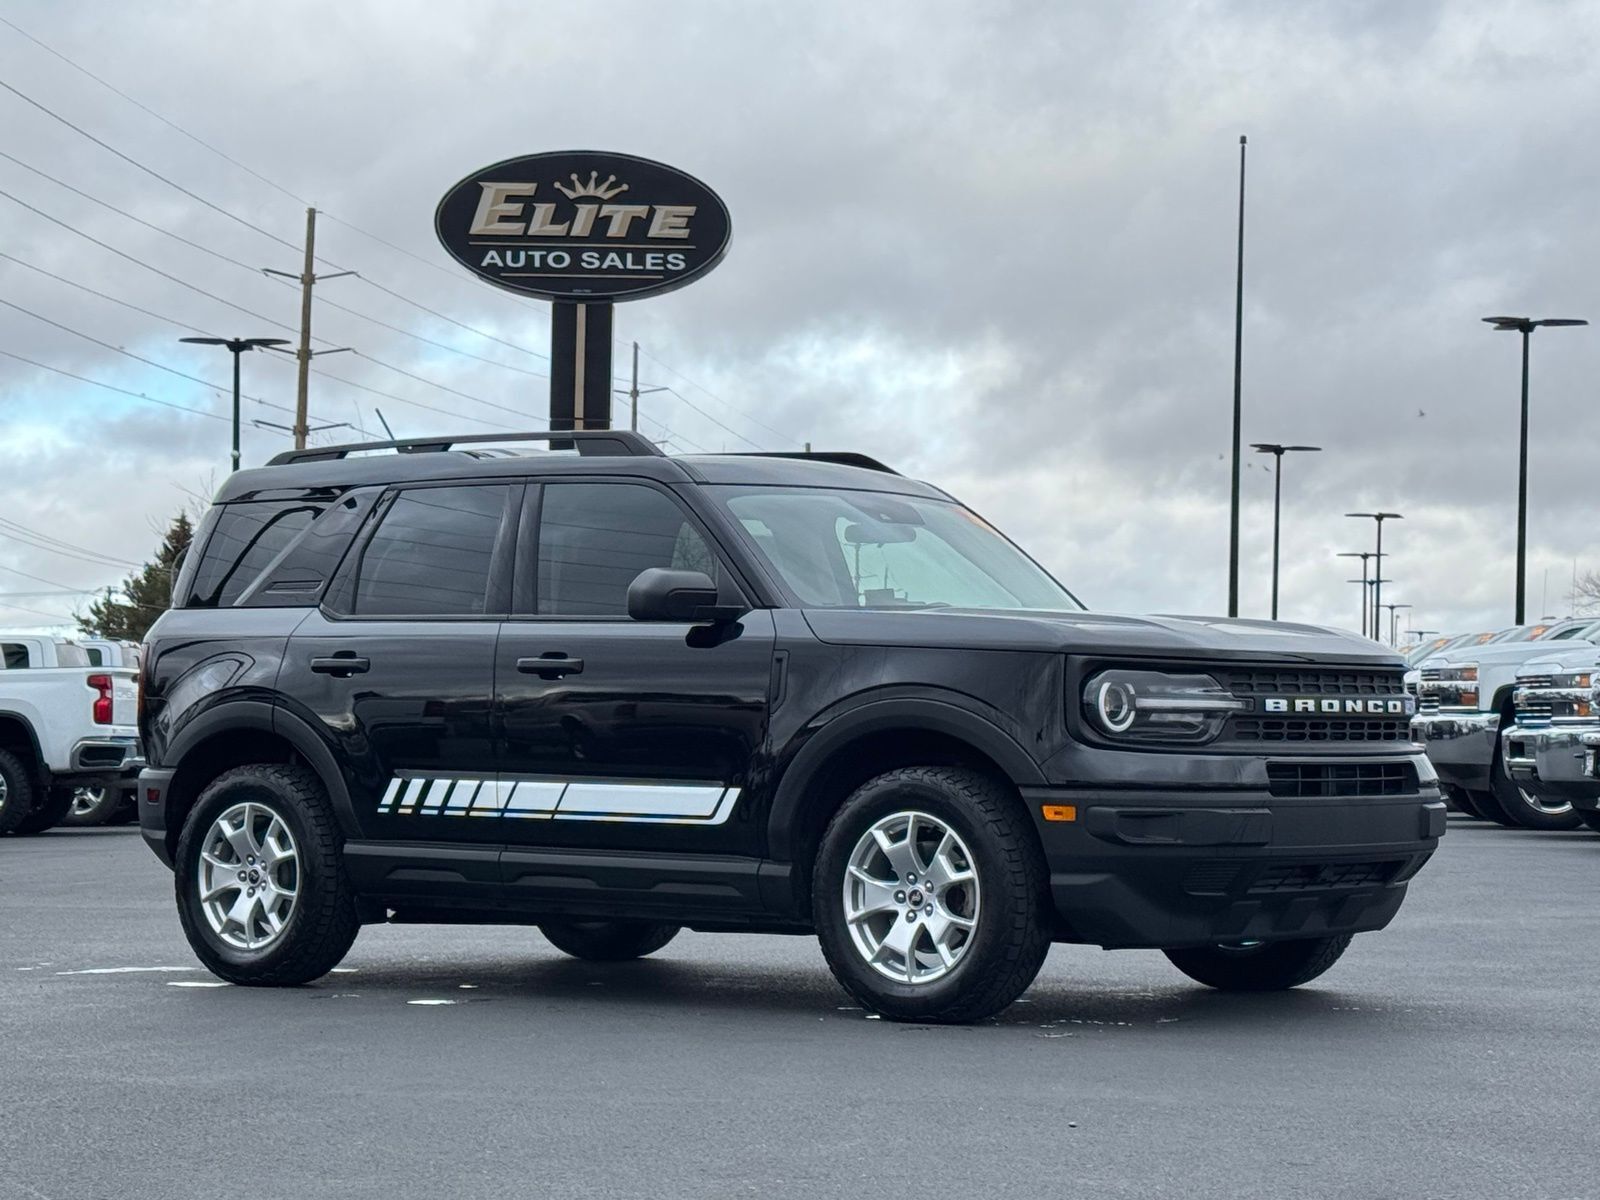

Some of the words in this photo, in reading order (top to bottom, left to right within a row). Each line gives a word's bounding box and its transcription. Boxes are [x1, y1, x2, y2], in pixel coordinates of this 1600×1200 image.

[469, 181, 697, 239] ELITE
[481, 250, 571, 269] AUTO
[580, 252, 686, 271] SALES
[1265, 698, 1402, 713] BRONCO
